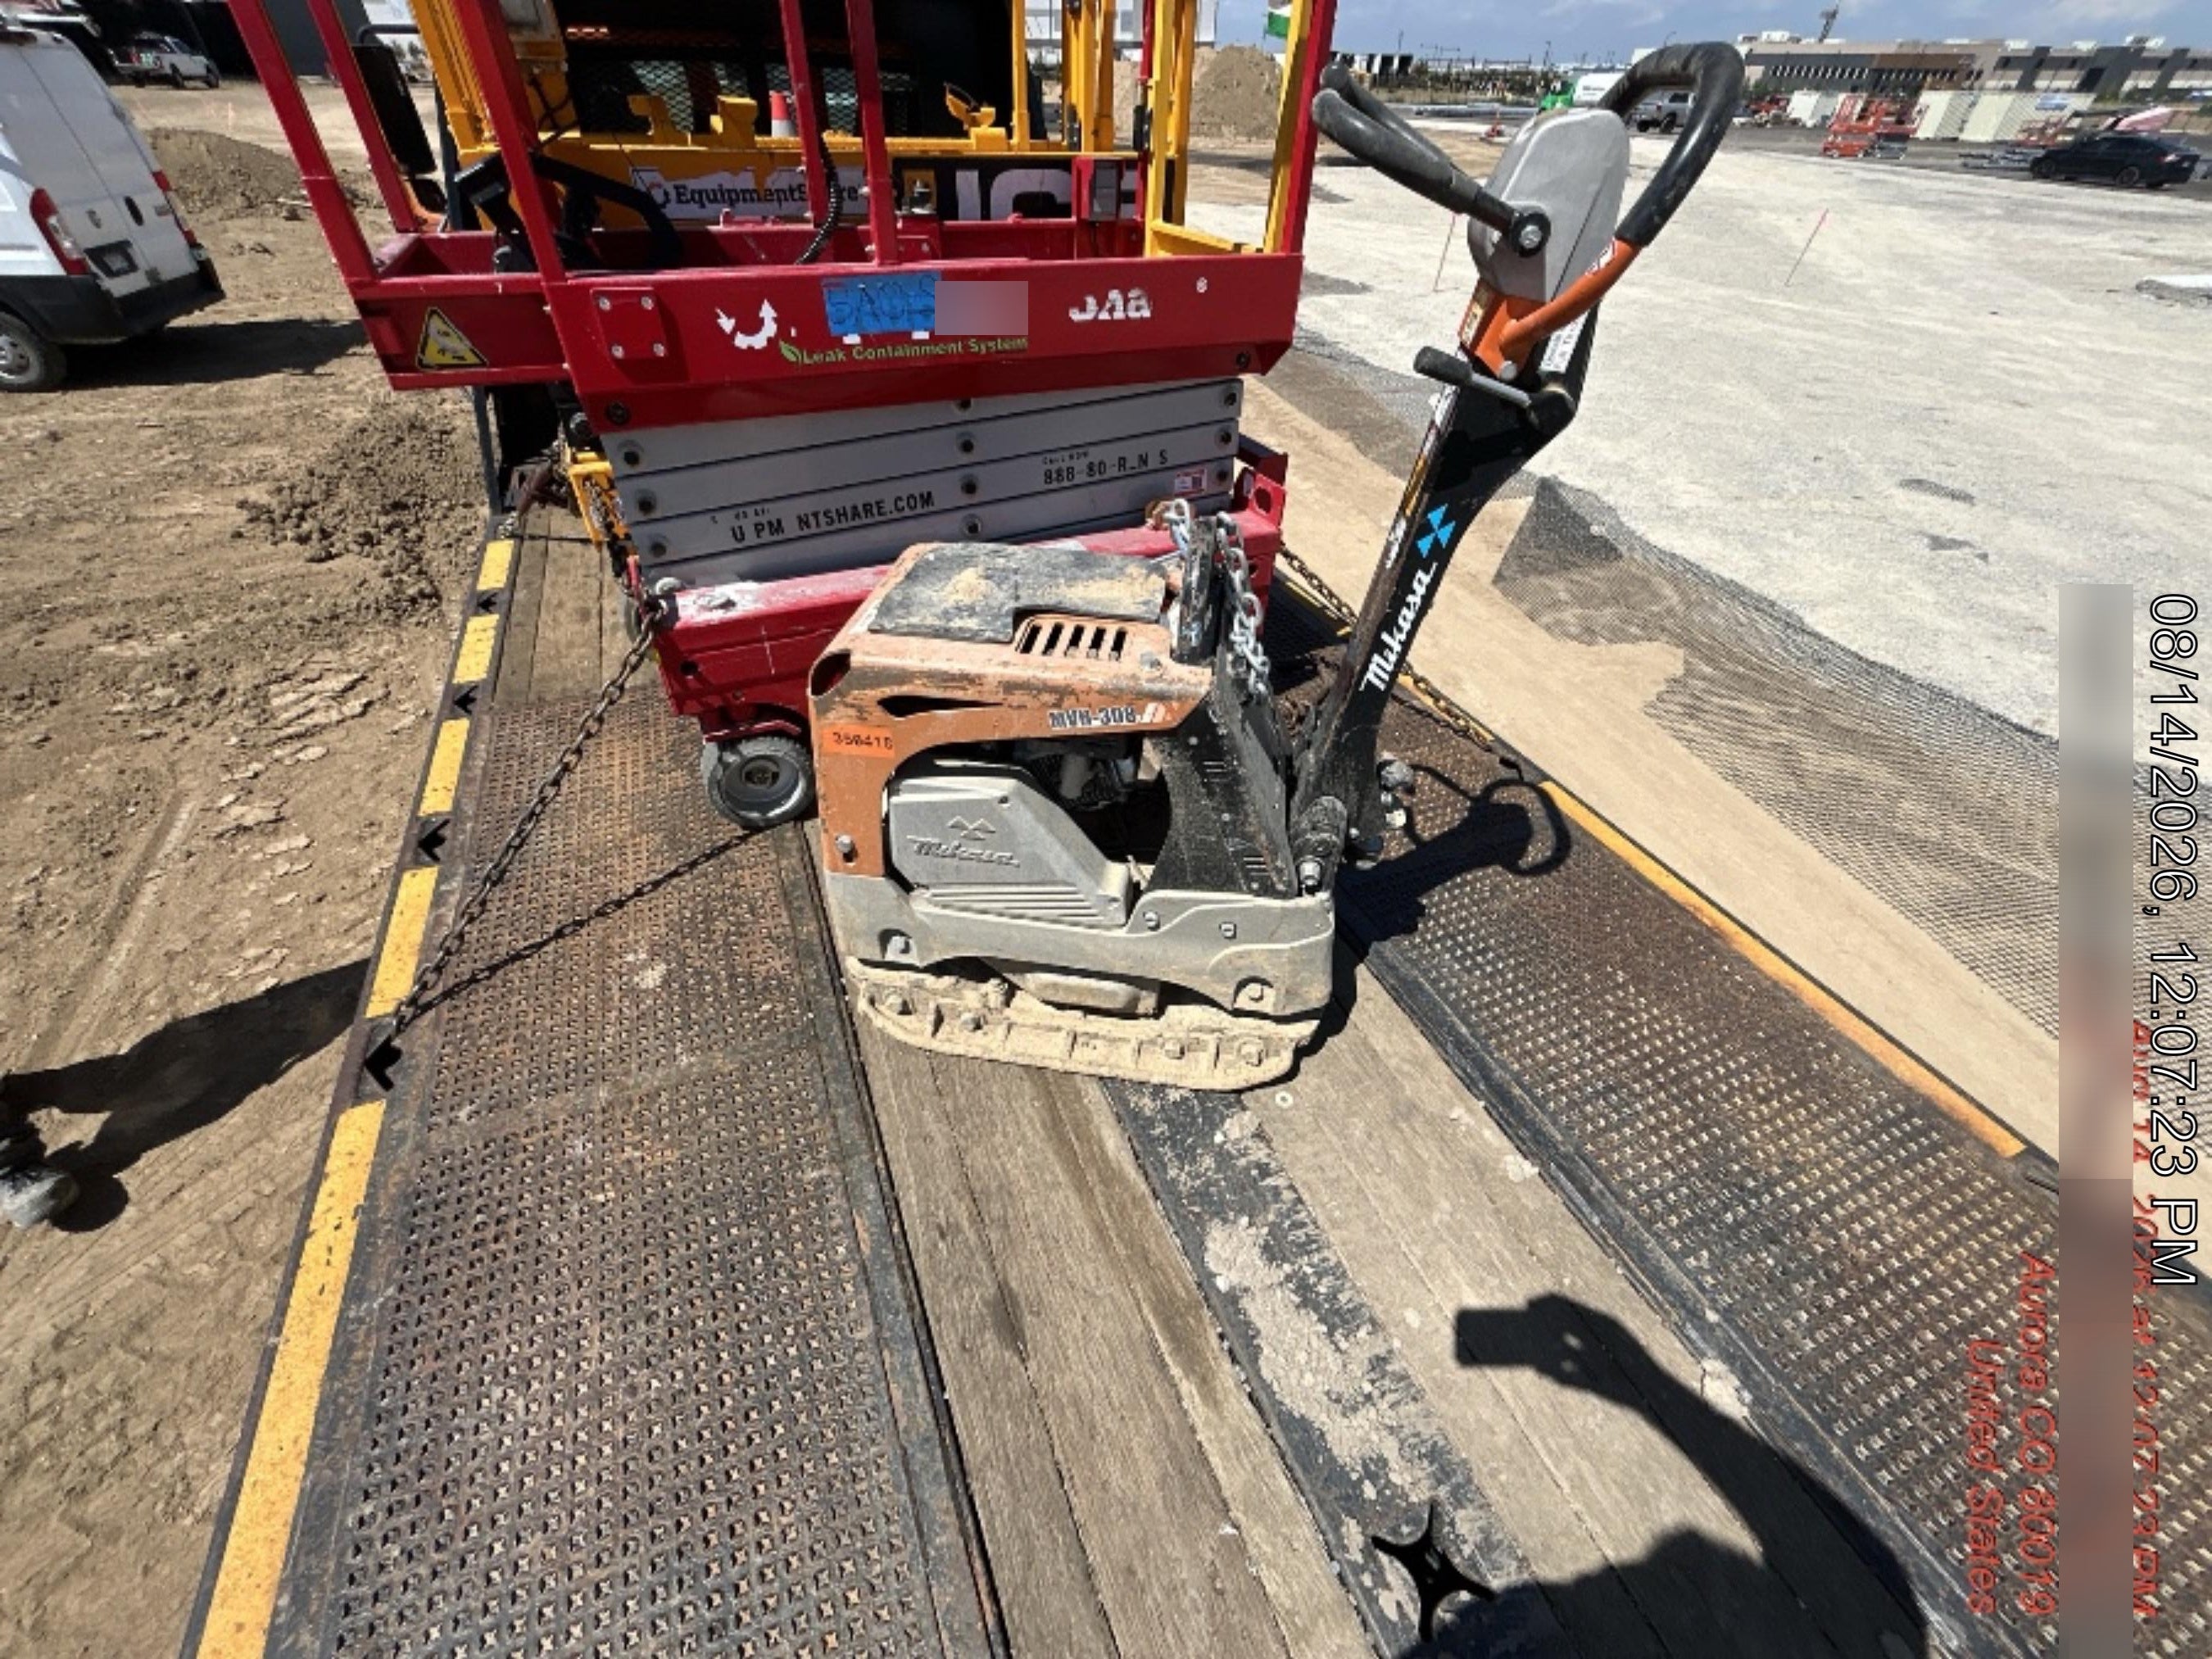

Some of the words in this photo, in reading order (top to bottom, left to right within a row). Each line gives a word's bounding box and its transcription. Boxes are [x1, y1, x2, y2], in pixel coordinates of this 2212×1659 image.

[852, 342, 963, 360] Containment
[969, 338, 1028, 355] System
[1358, 561, 1439, 692] Mikasa
